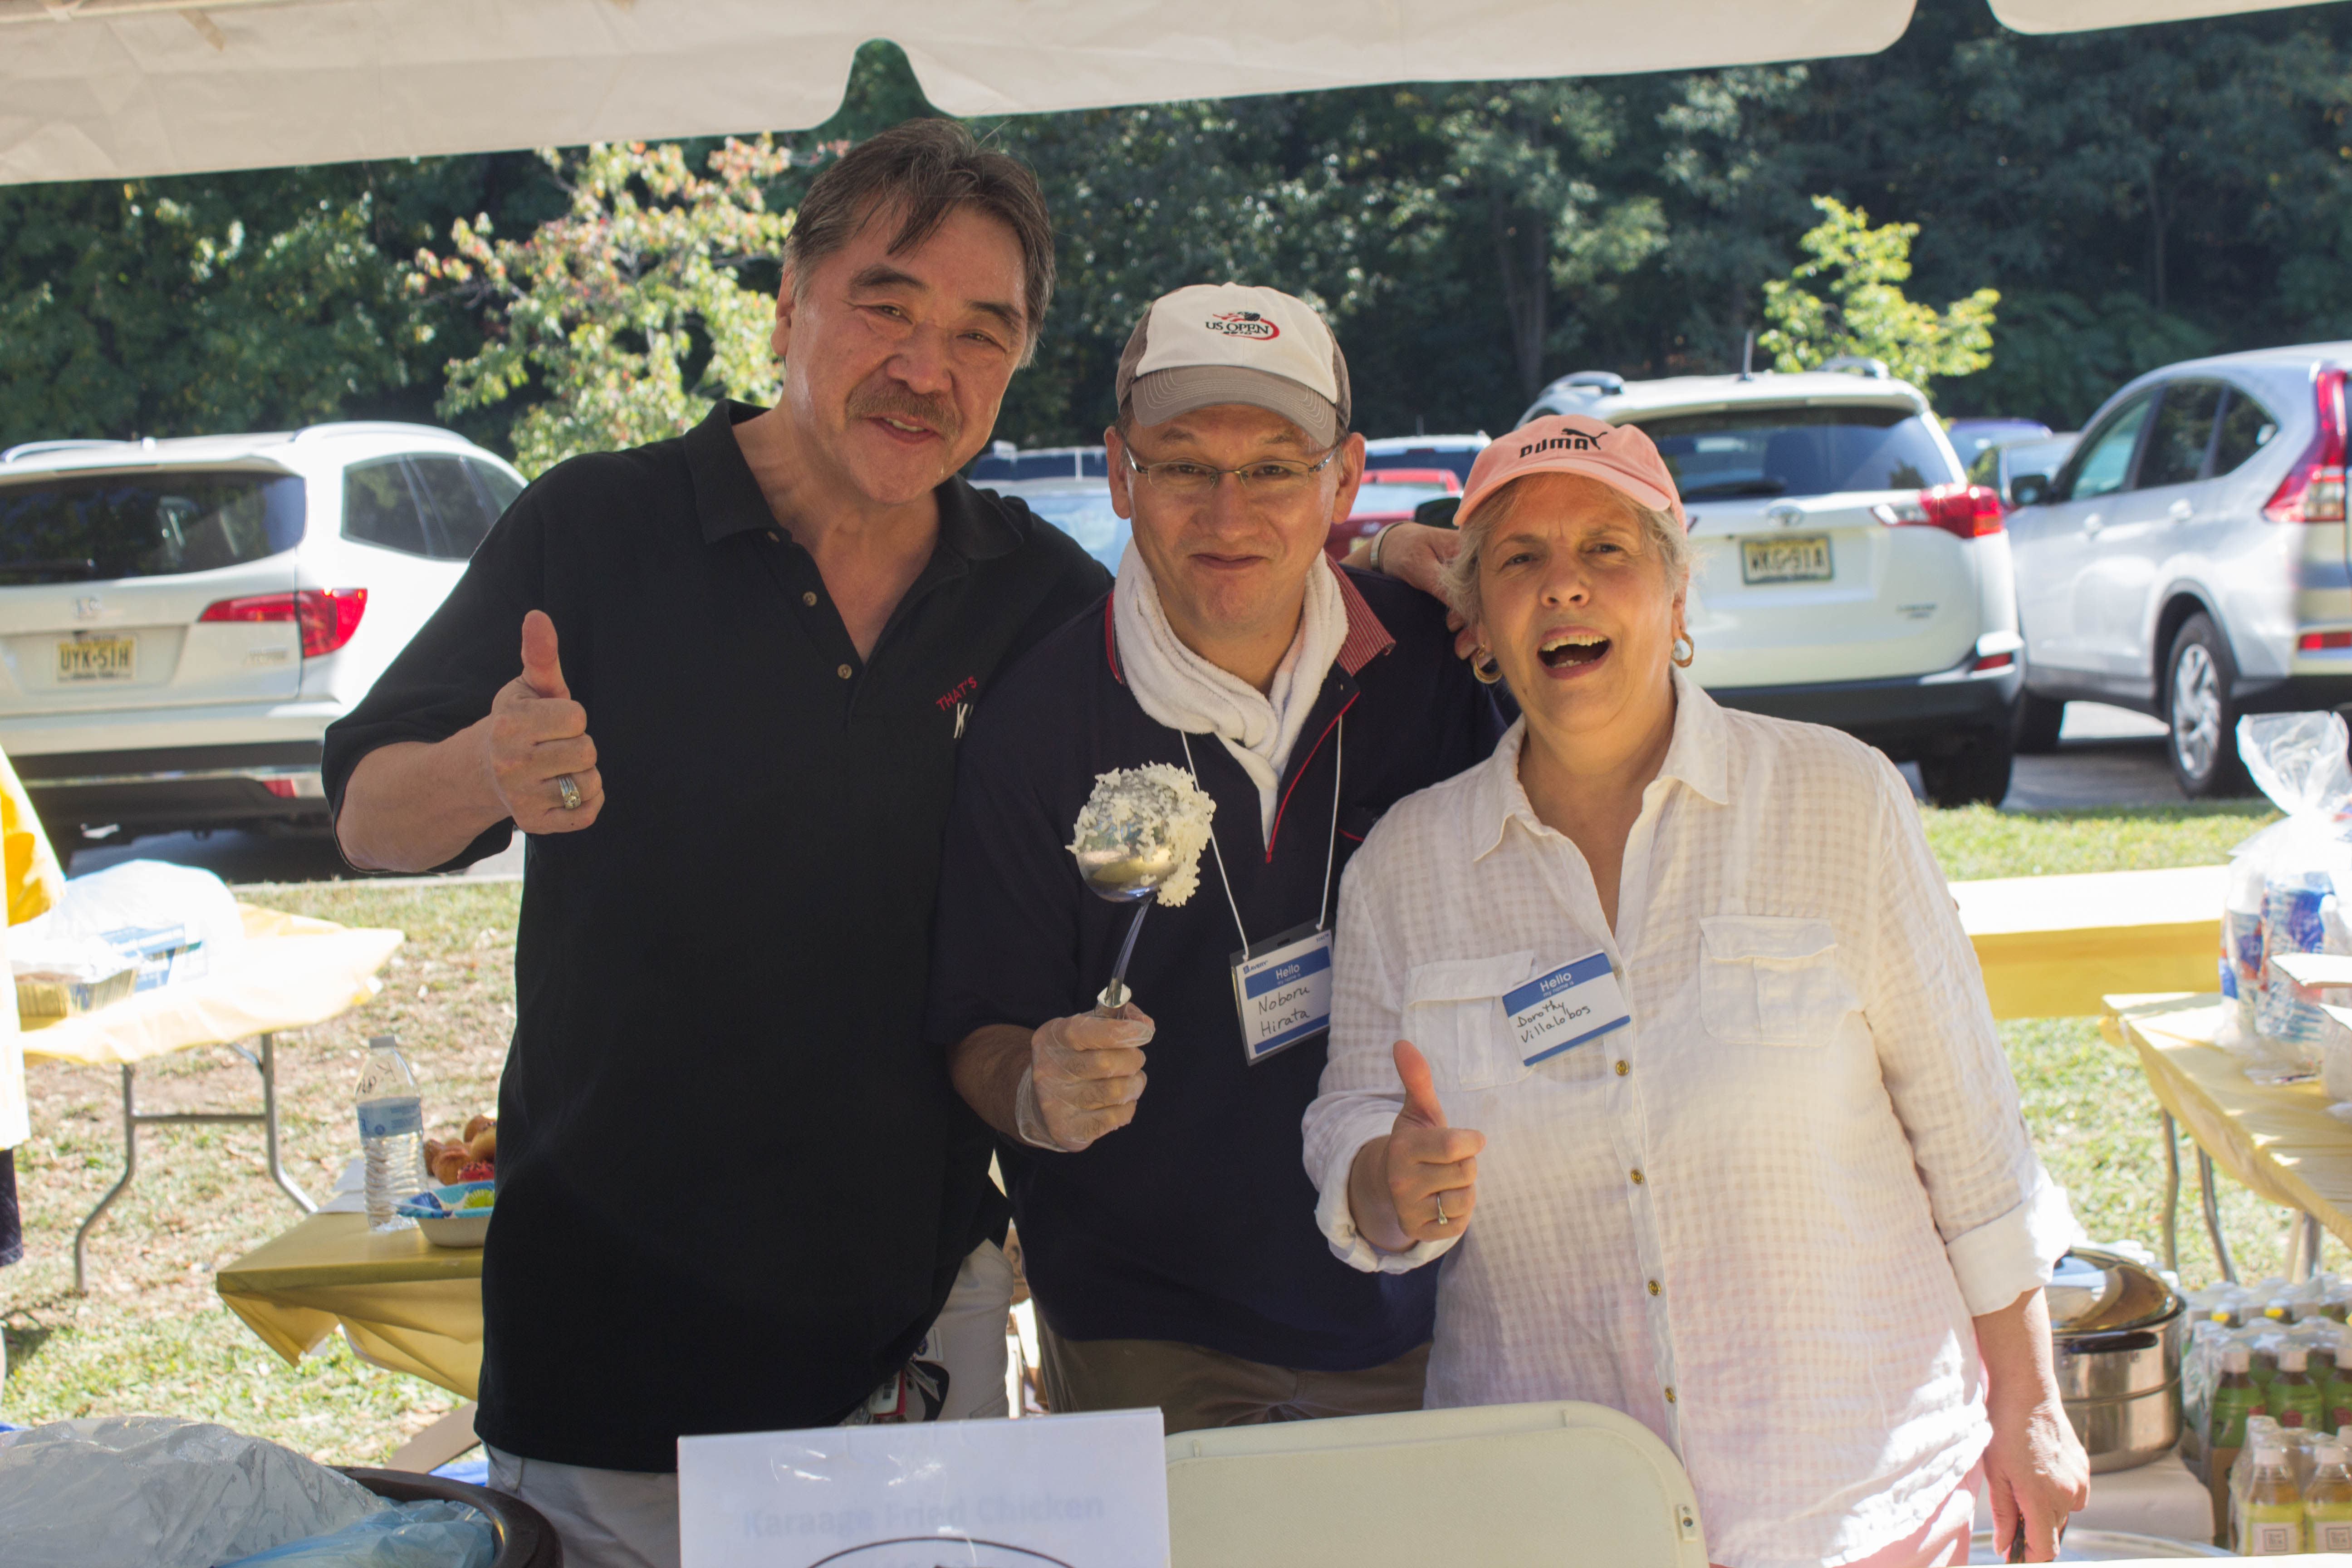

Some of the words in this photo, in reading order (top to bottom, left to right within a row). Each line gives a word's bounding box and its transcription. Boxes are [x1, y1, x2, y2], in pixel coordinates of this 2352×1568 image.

[1205, 321, 1223, 330] US
[1226, 323, 1269, 334] OPEN
[1519, 438, 1588, 458] PUMA
[935, 676, 977, 711] THAT'S
[1250, 960, 1267, 971] AVERY
[1275, 964, 1300, 980] Hello
[1539, 972, 1572, 992] Hello
[1258, 986, 1310, 1015] Noboru
[1517, 999, 1567, 1028] Dorothy
[1260, 1008, 1310, 1037] Hirata
[1521, 1005, 1591, 1043] Villalobos
[743, 1507, 876, 1539] Karaage
[885, 1499, 968, 1529] Fried
[977, 1493, 1106, 1524] Chicken
